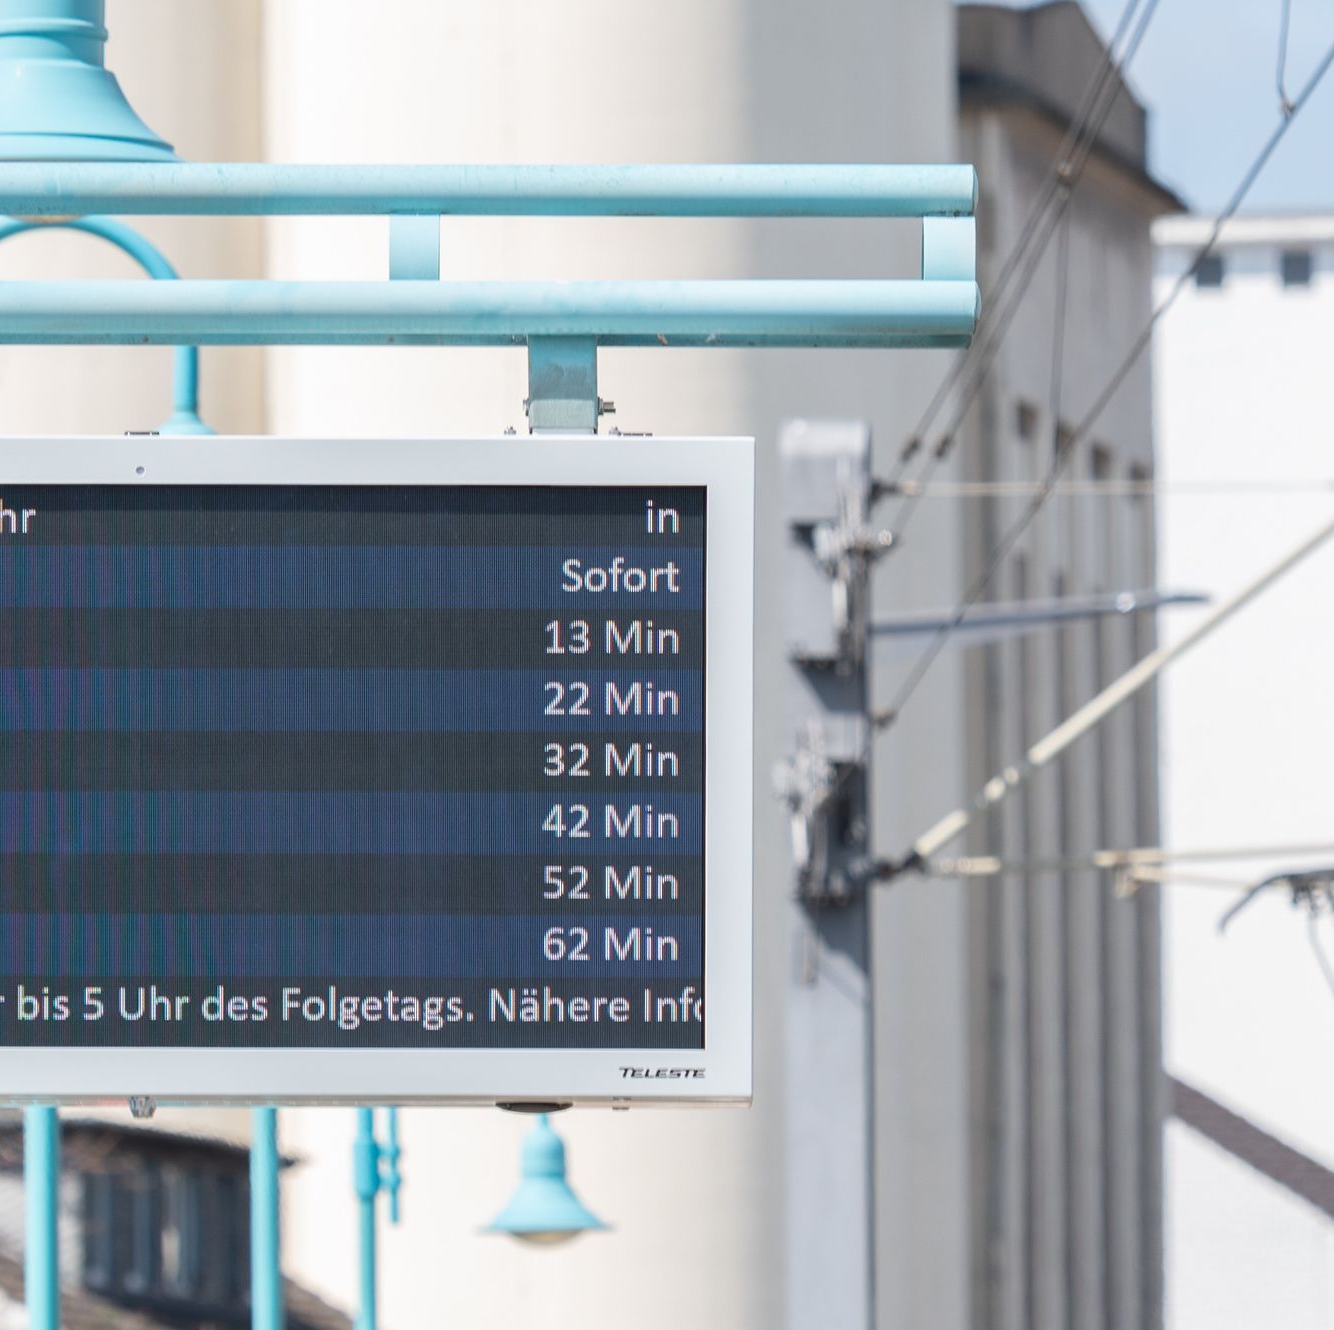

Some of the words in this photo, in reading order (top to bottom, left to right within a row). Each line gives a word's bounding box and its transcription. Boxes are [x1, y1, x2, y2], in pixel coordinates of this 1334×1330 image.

[647, 500, 679, 534] in
[562, 556, 680, 593] Sofort
[546, 620, 591, 654] 13
[605, 620, 679, 654] Min
[544, 681, 591, 716] 22
[605, 681, 679, 716] Min
[544, 742, 591, 777] 32
[605, 742, 679, 777] Min
[542, 803, 591, 838] 42
[605, 803, 679, 838] Min
[543, 865, 591, 900] 52
[605, 865, 679, 900] Min
[543, 926, 591, 961] 62
[605, 926, 679, 961] Min
[17, 984, 70, 1021] bis
[84, 986, 105, 1021] 5
[119, 985, 190, 1021] Uhr
[201, 985, 269, 1021] des
[282, 985, 474, 1031] Folgetags.
[490, 986, 630, 1022] Nähere
[619, 1066, 706, 1078] TELESTE
